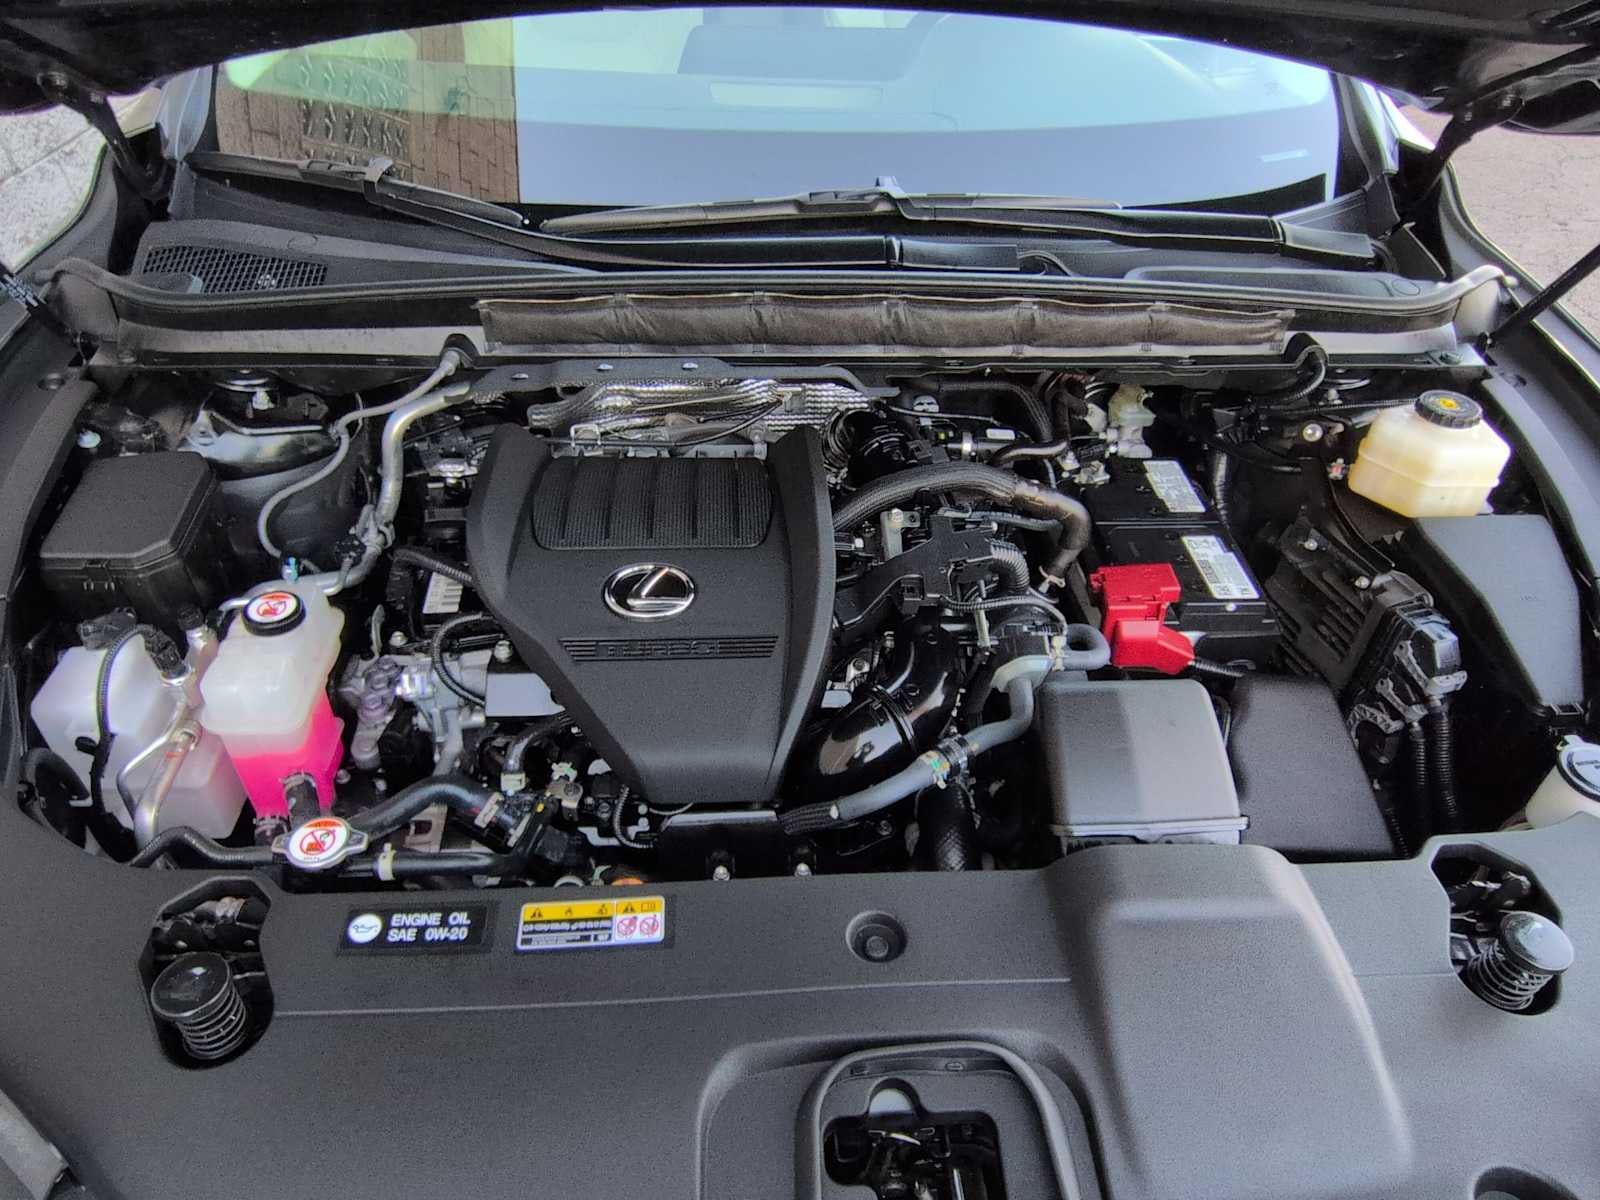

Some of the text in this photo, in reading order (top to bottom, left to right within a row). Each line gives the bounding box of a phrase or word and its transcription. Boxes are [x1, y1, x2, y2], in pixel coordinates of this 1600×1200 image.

[391, 911, 471, 926] ENGINE OIL
[387, 927, 468, 942] SAE 0W-20
